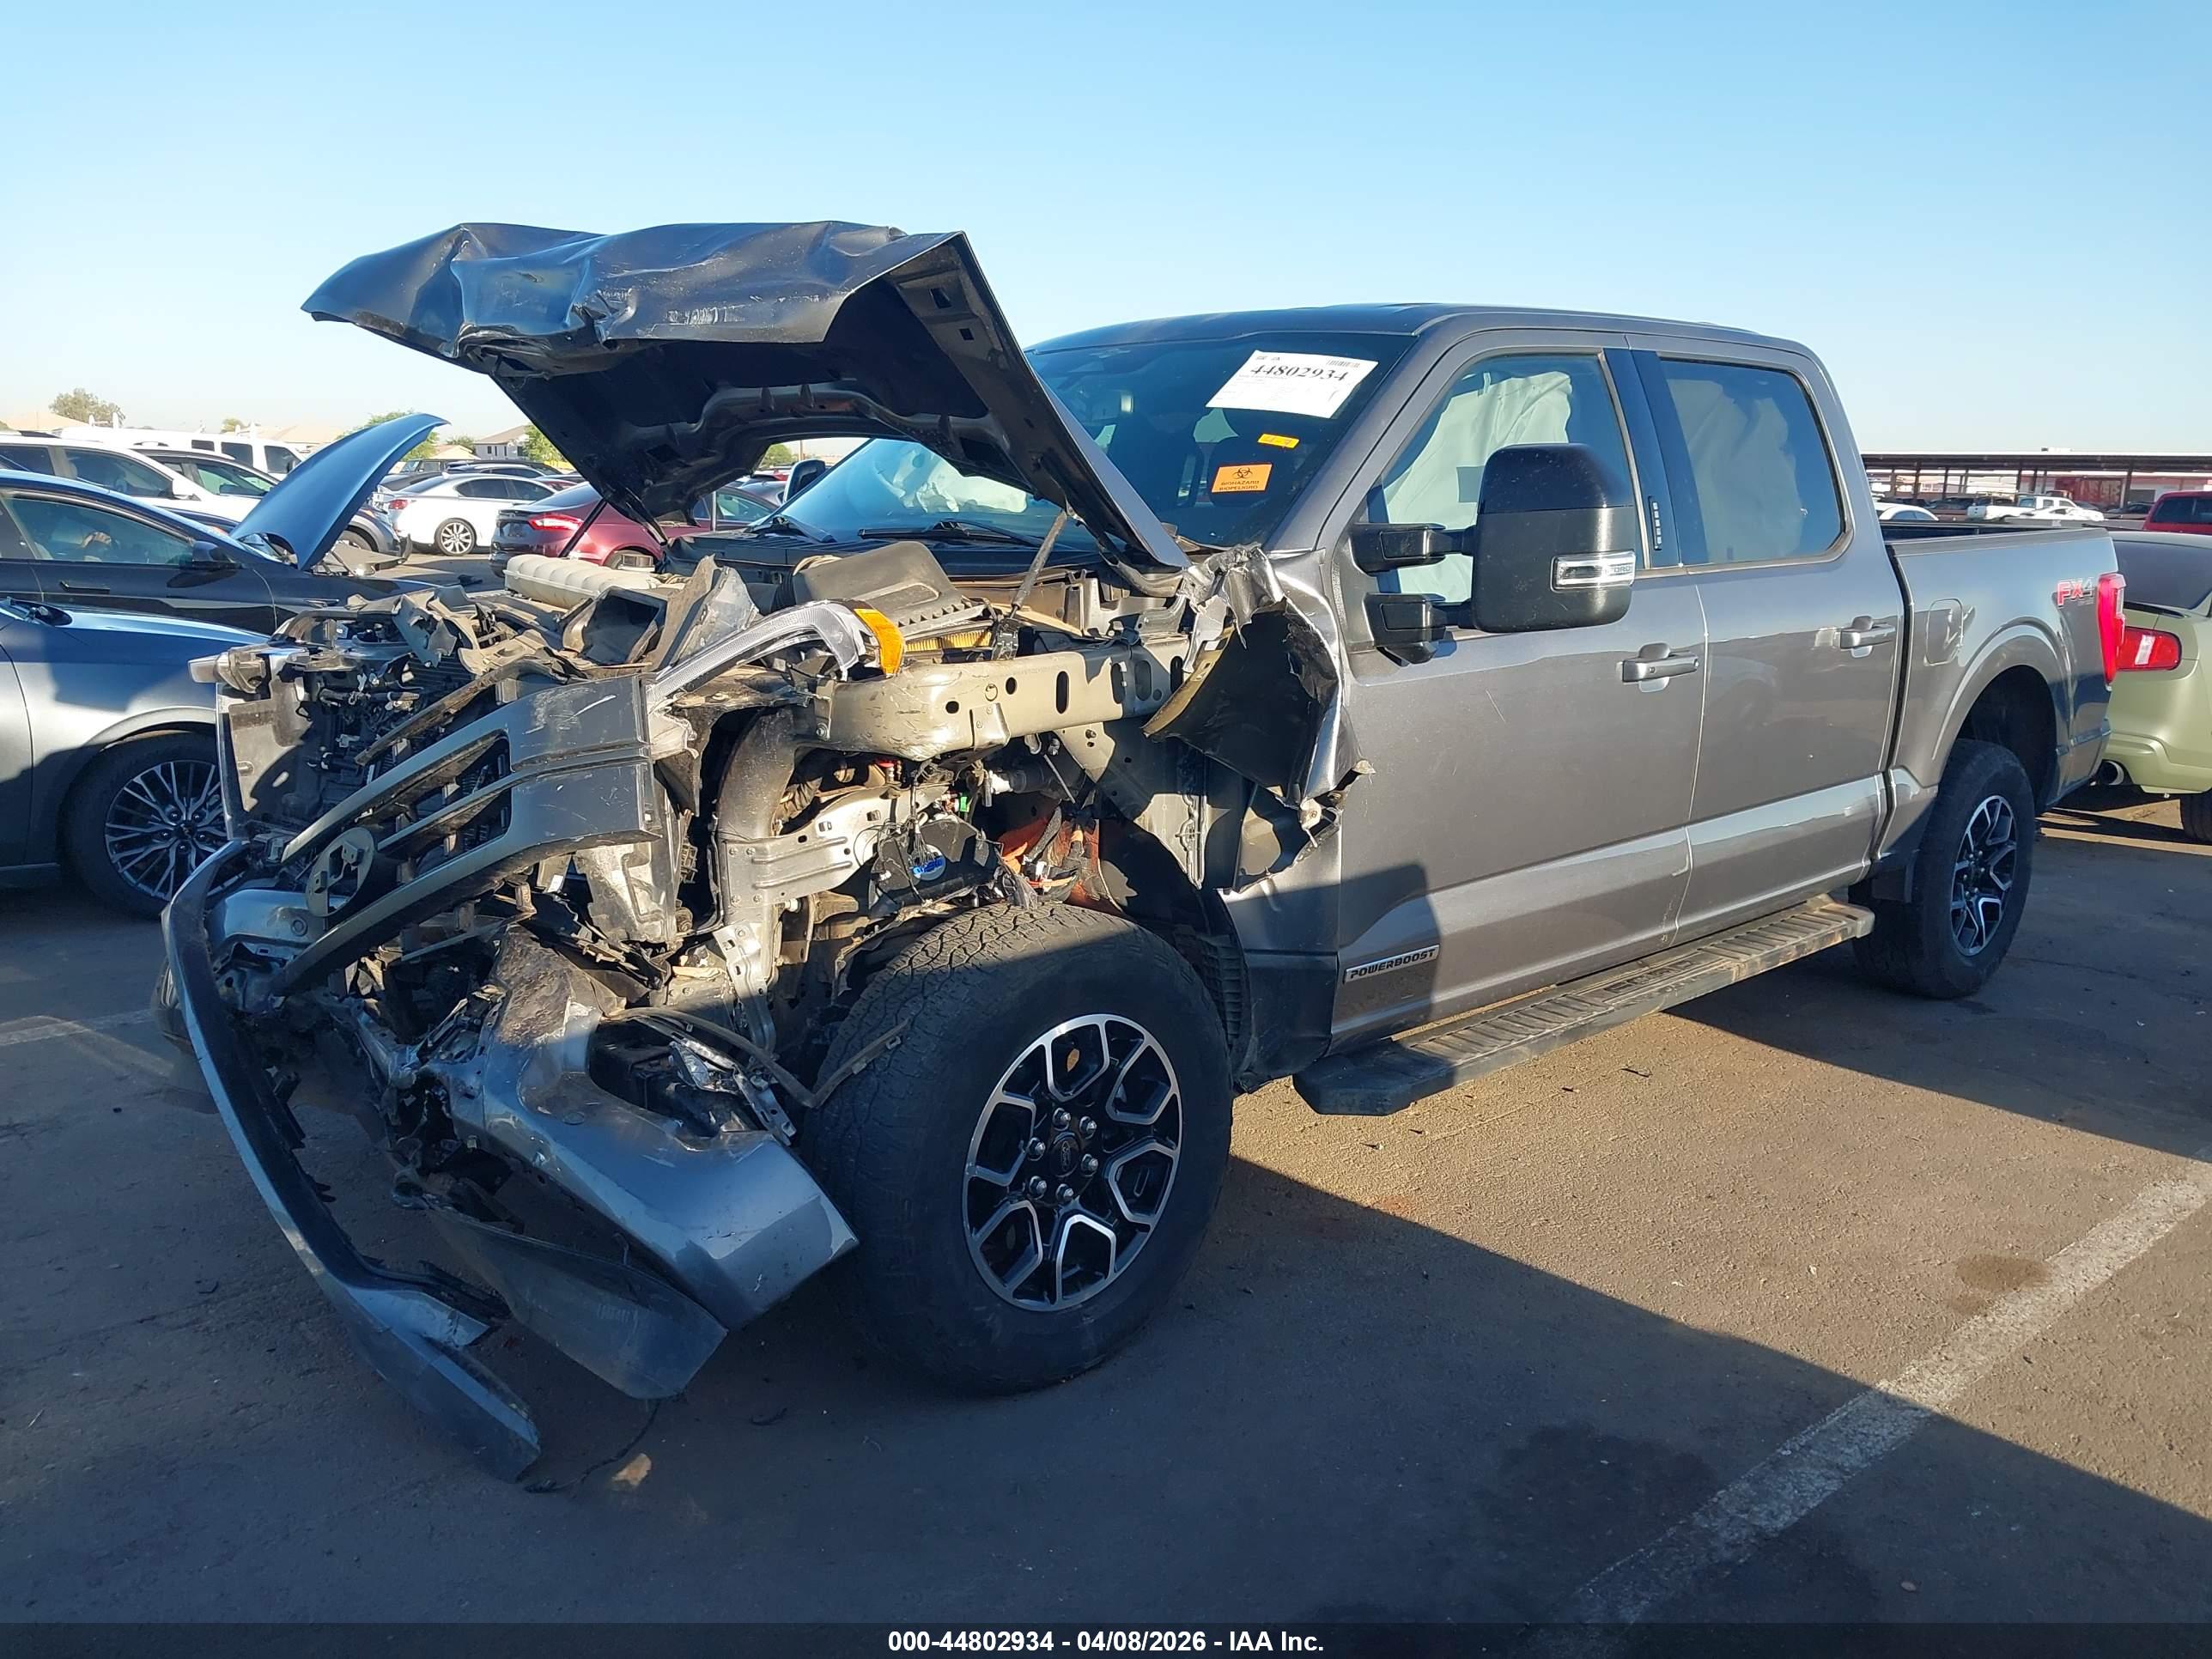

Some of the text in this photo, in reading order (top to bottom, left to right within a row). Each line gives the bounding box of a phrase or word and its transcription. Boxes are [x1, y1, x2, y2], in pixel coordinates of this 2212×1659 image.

[1250, 364, 1349, 381] 44802934
[2057, 577, 2094, 606] FX4
[1350, 949, 1435, 979] POWERBOOST
